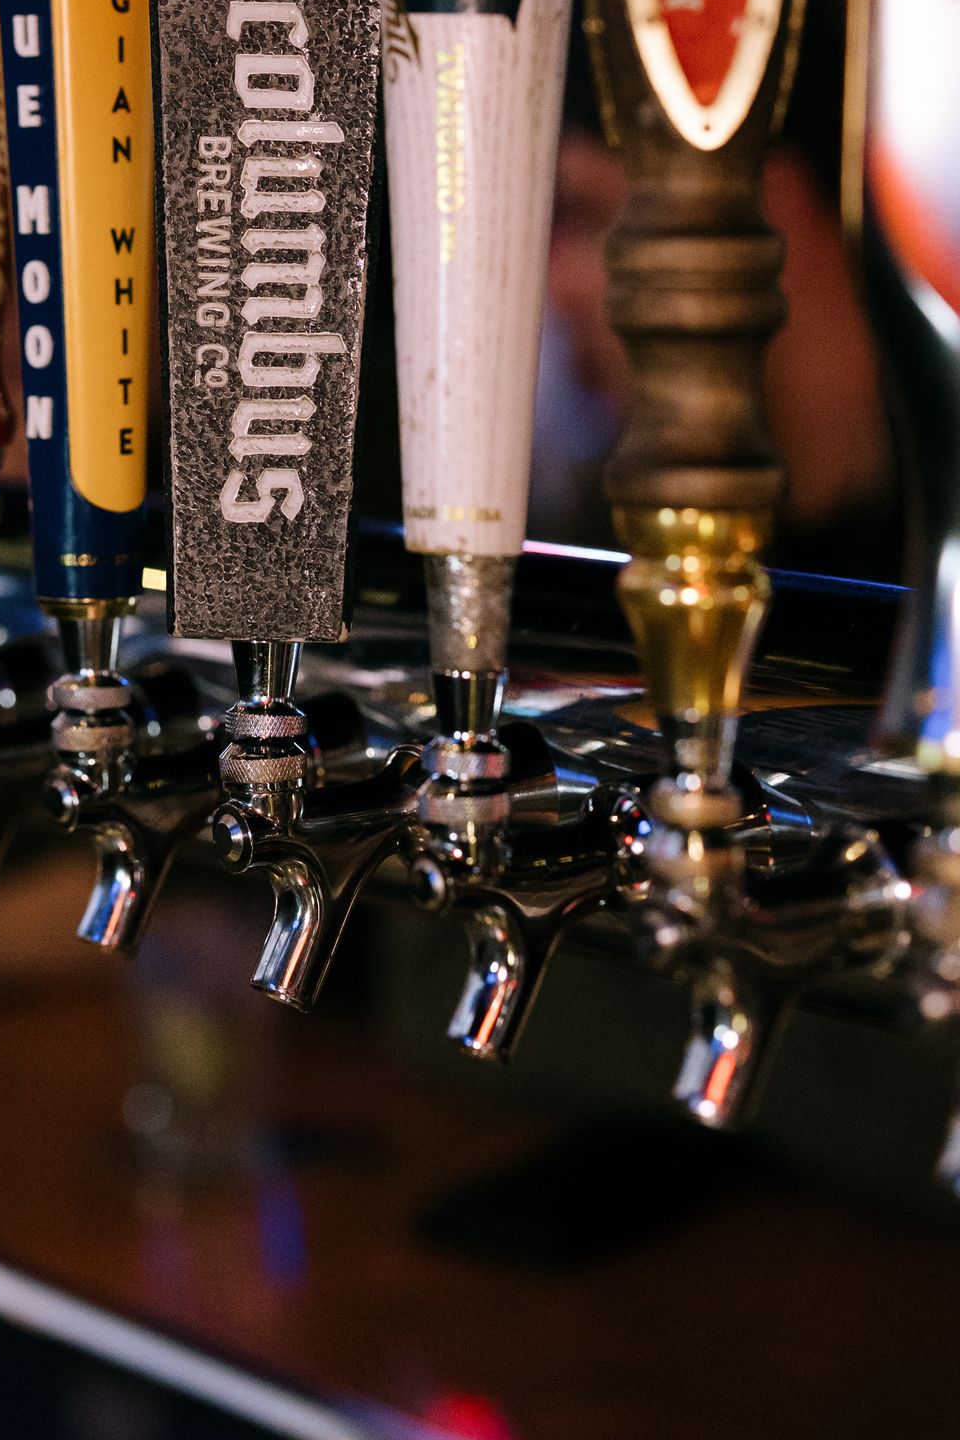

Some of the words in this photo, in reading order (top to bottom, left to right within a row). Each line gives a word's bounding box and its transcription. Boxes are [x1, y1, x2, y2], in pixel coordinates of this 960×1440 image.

[16, 185, 53, 440] MOON
[112, 229, 134, 454] WHITE
[196, 136, 232, 328] BREWING
